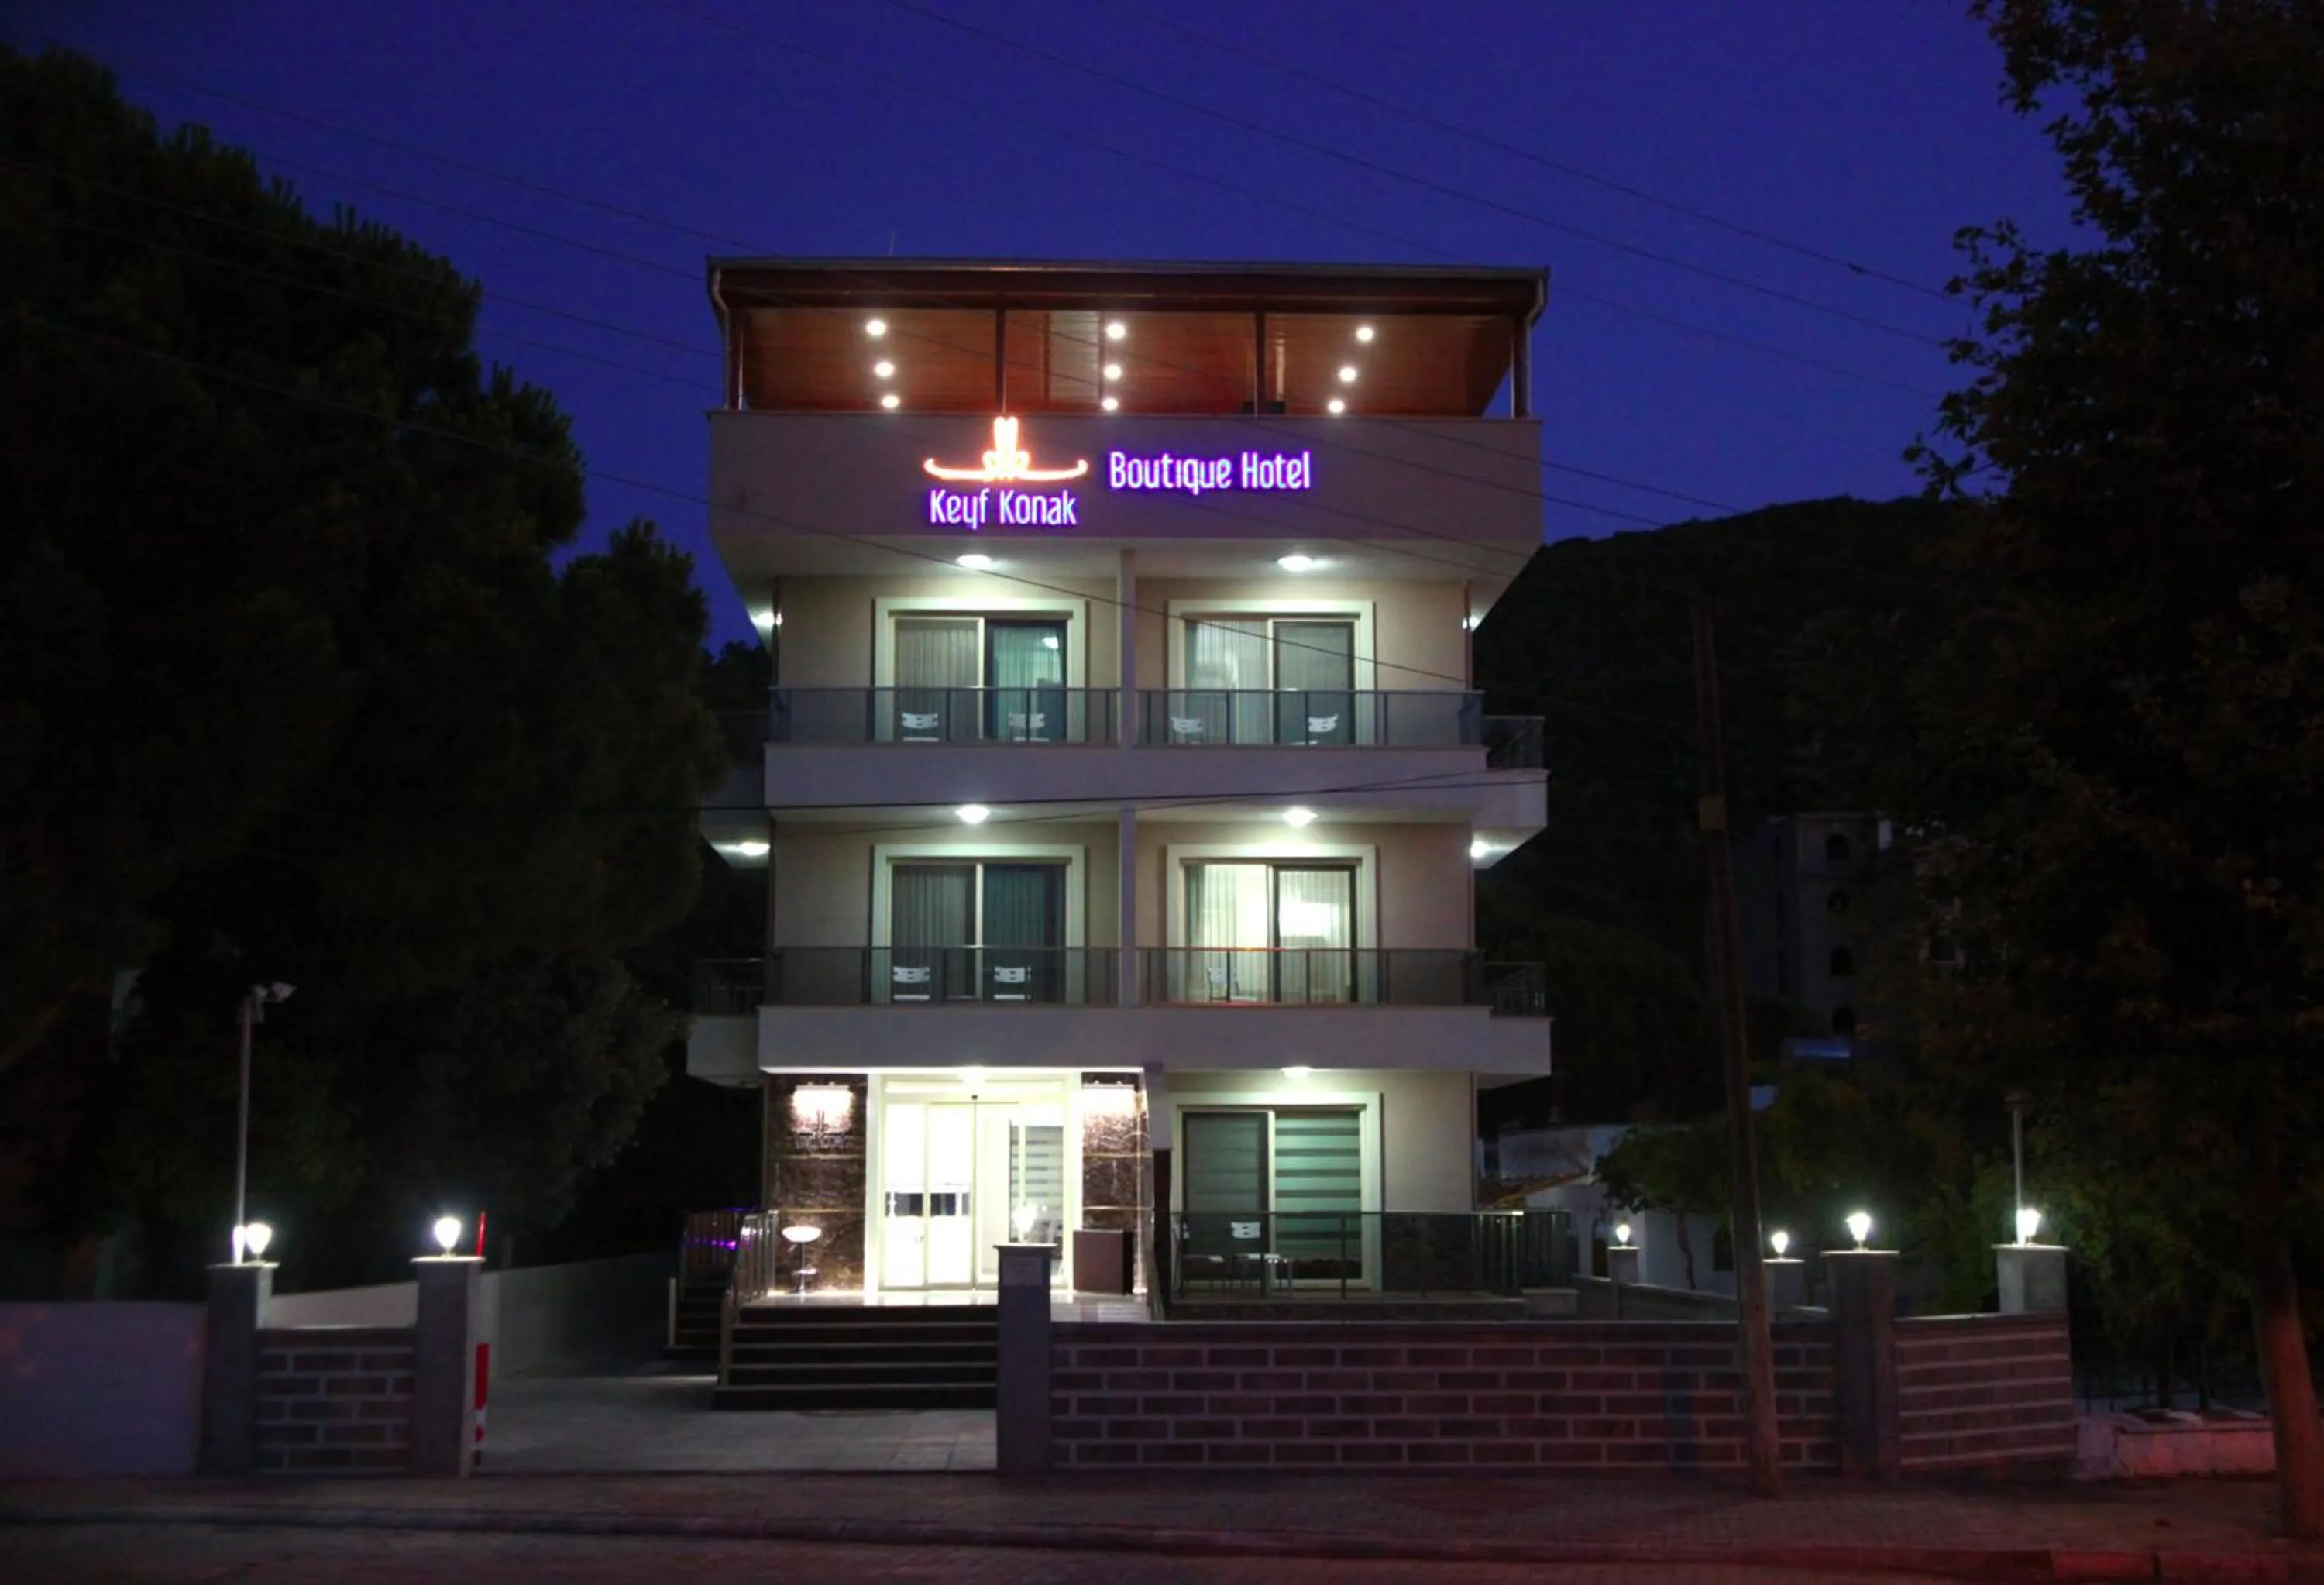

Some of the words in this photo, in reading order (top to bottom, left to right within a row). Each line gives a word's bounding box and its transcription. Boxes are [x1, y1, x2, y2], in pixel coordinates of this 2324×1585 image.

[1109, 451, 1232, 496] Boutique
[1241, 451, 1312, 489] Hotel
[930, 487, 991, 530] Keyf
[999, 489, 1078, 525] Konak
